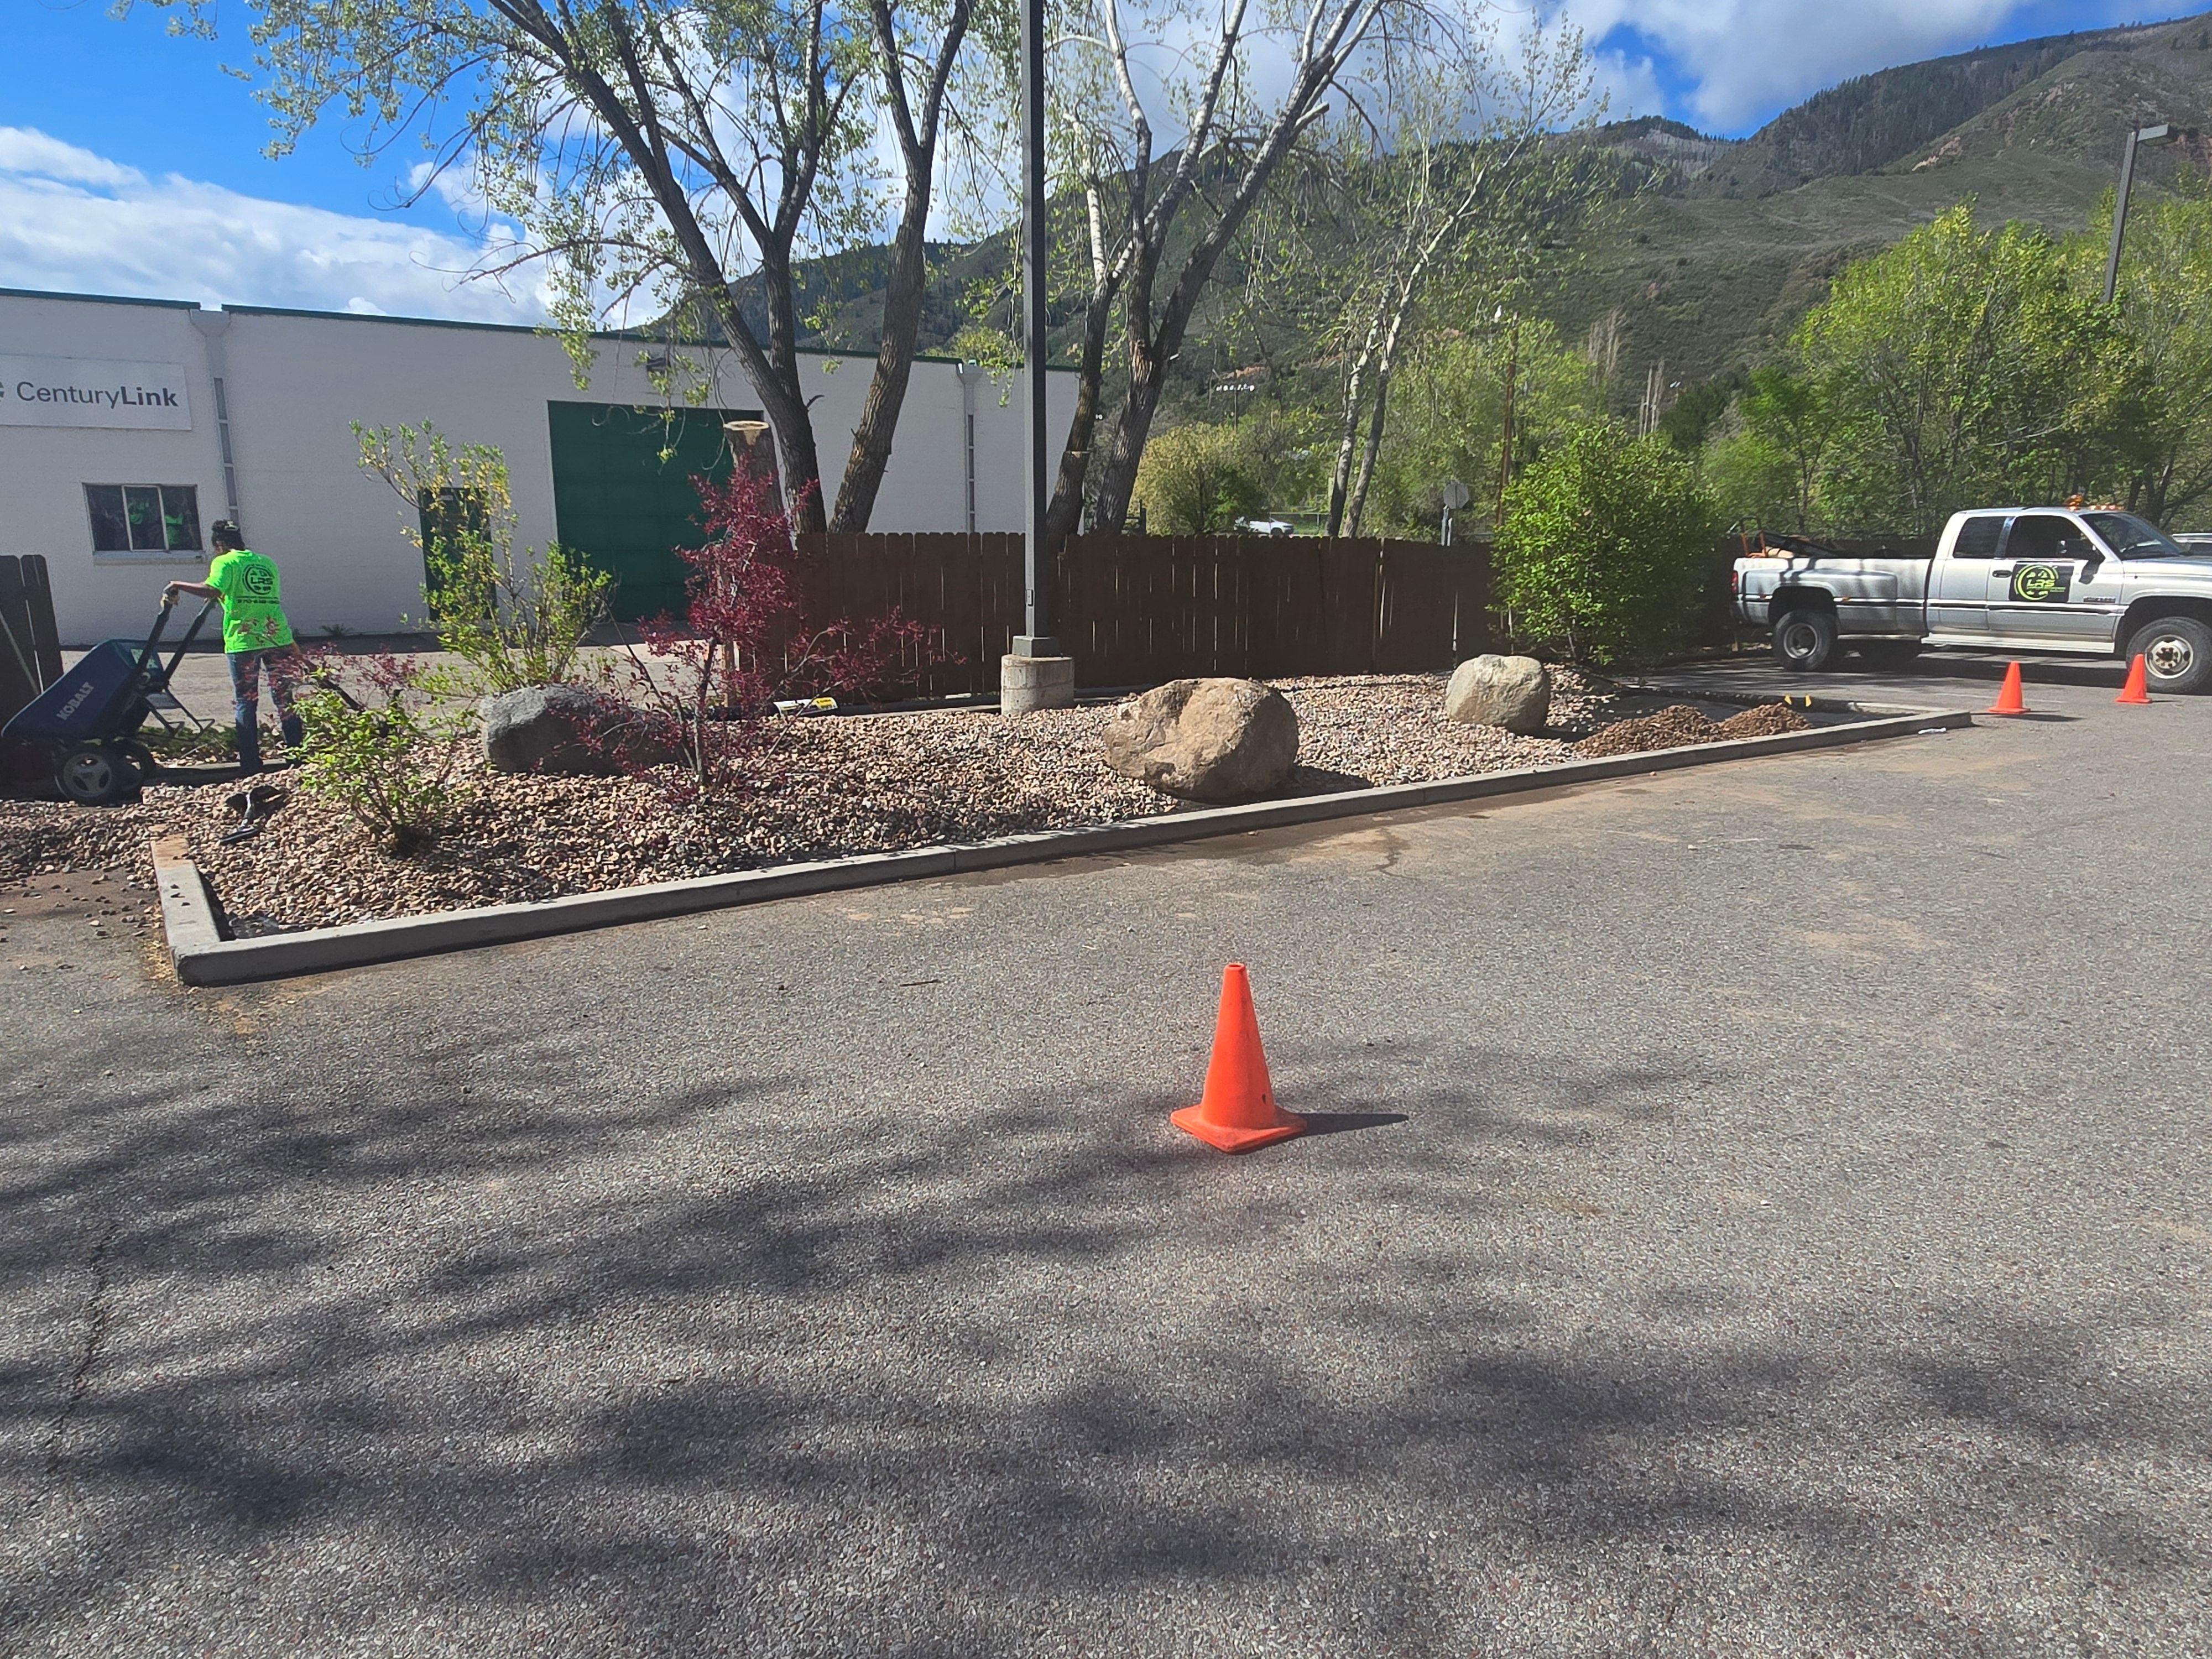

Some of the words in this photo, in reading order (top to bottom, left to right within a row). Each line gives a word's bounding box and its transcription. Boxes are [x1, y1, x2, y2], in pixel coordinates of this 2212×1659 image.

[17, 381, 179, 409] CenturyLink
[2026, 579, 2056, 587] LRS
[56, 681, 94, 720] KOBALT
